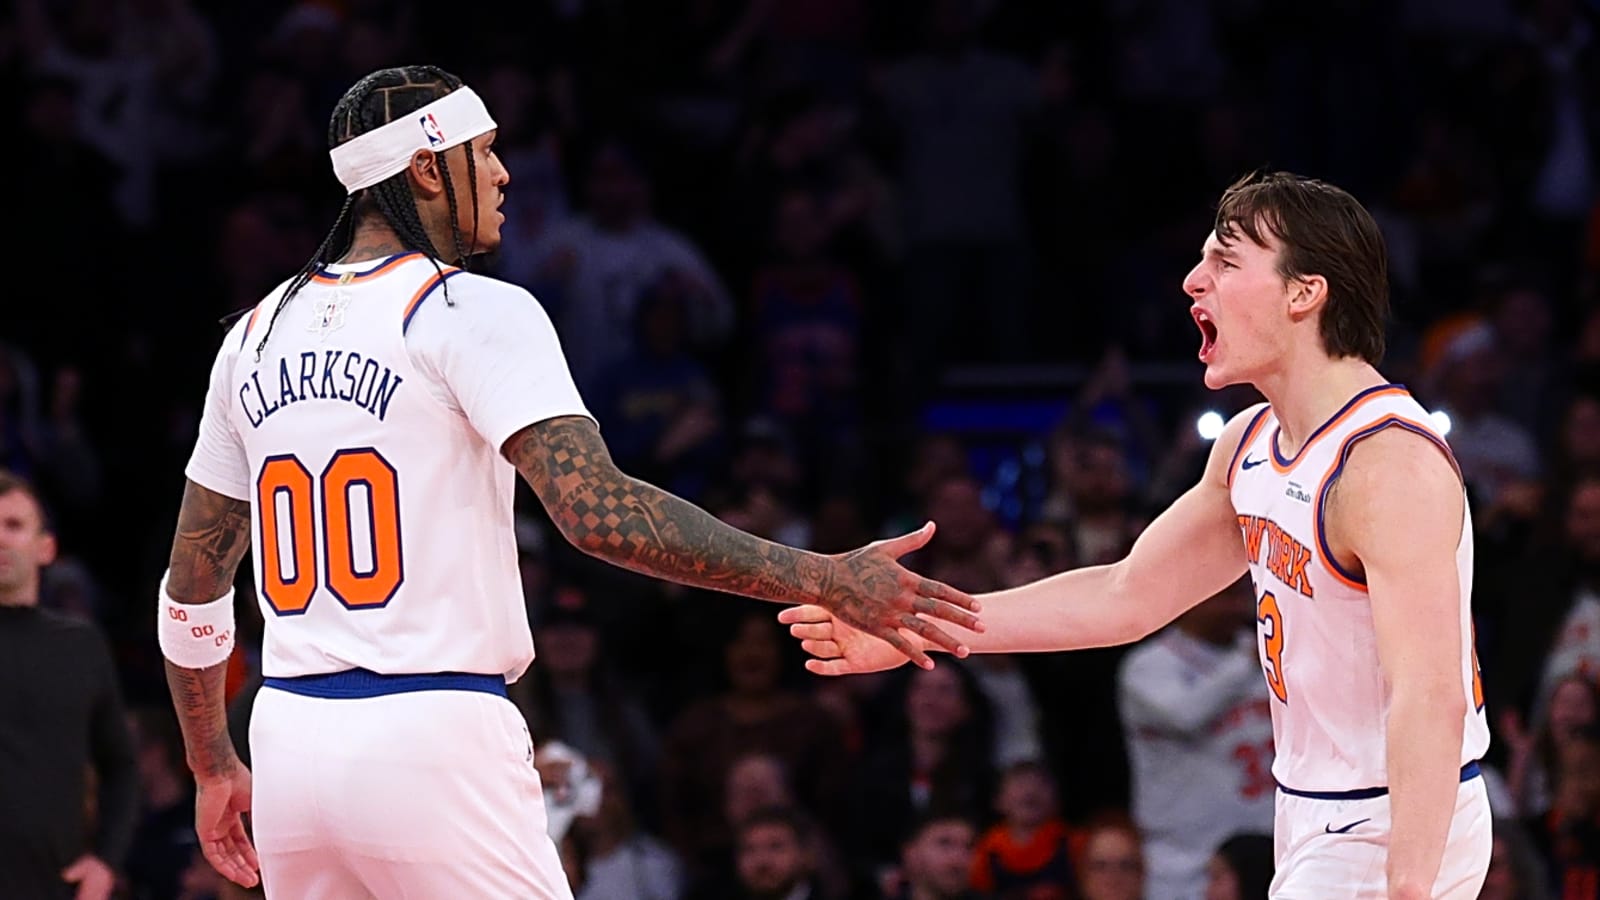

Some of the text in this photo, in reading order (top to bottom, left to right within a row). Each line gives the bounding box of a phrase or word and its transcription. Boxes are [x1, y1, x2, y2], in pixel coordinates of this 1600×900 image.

[239, 350, 403, 429] CLARKSON
[257, 447, 404, 616] 00
[1266, 518, 1313, 599] YORK
[168, 606, 188, 622] 00
[191, 624, 214, 638] 00
[1254, 582, 1288, 706] 3
